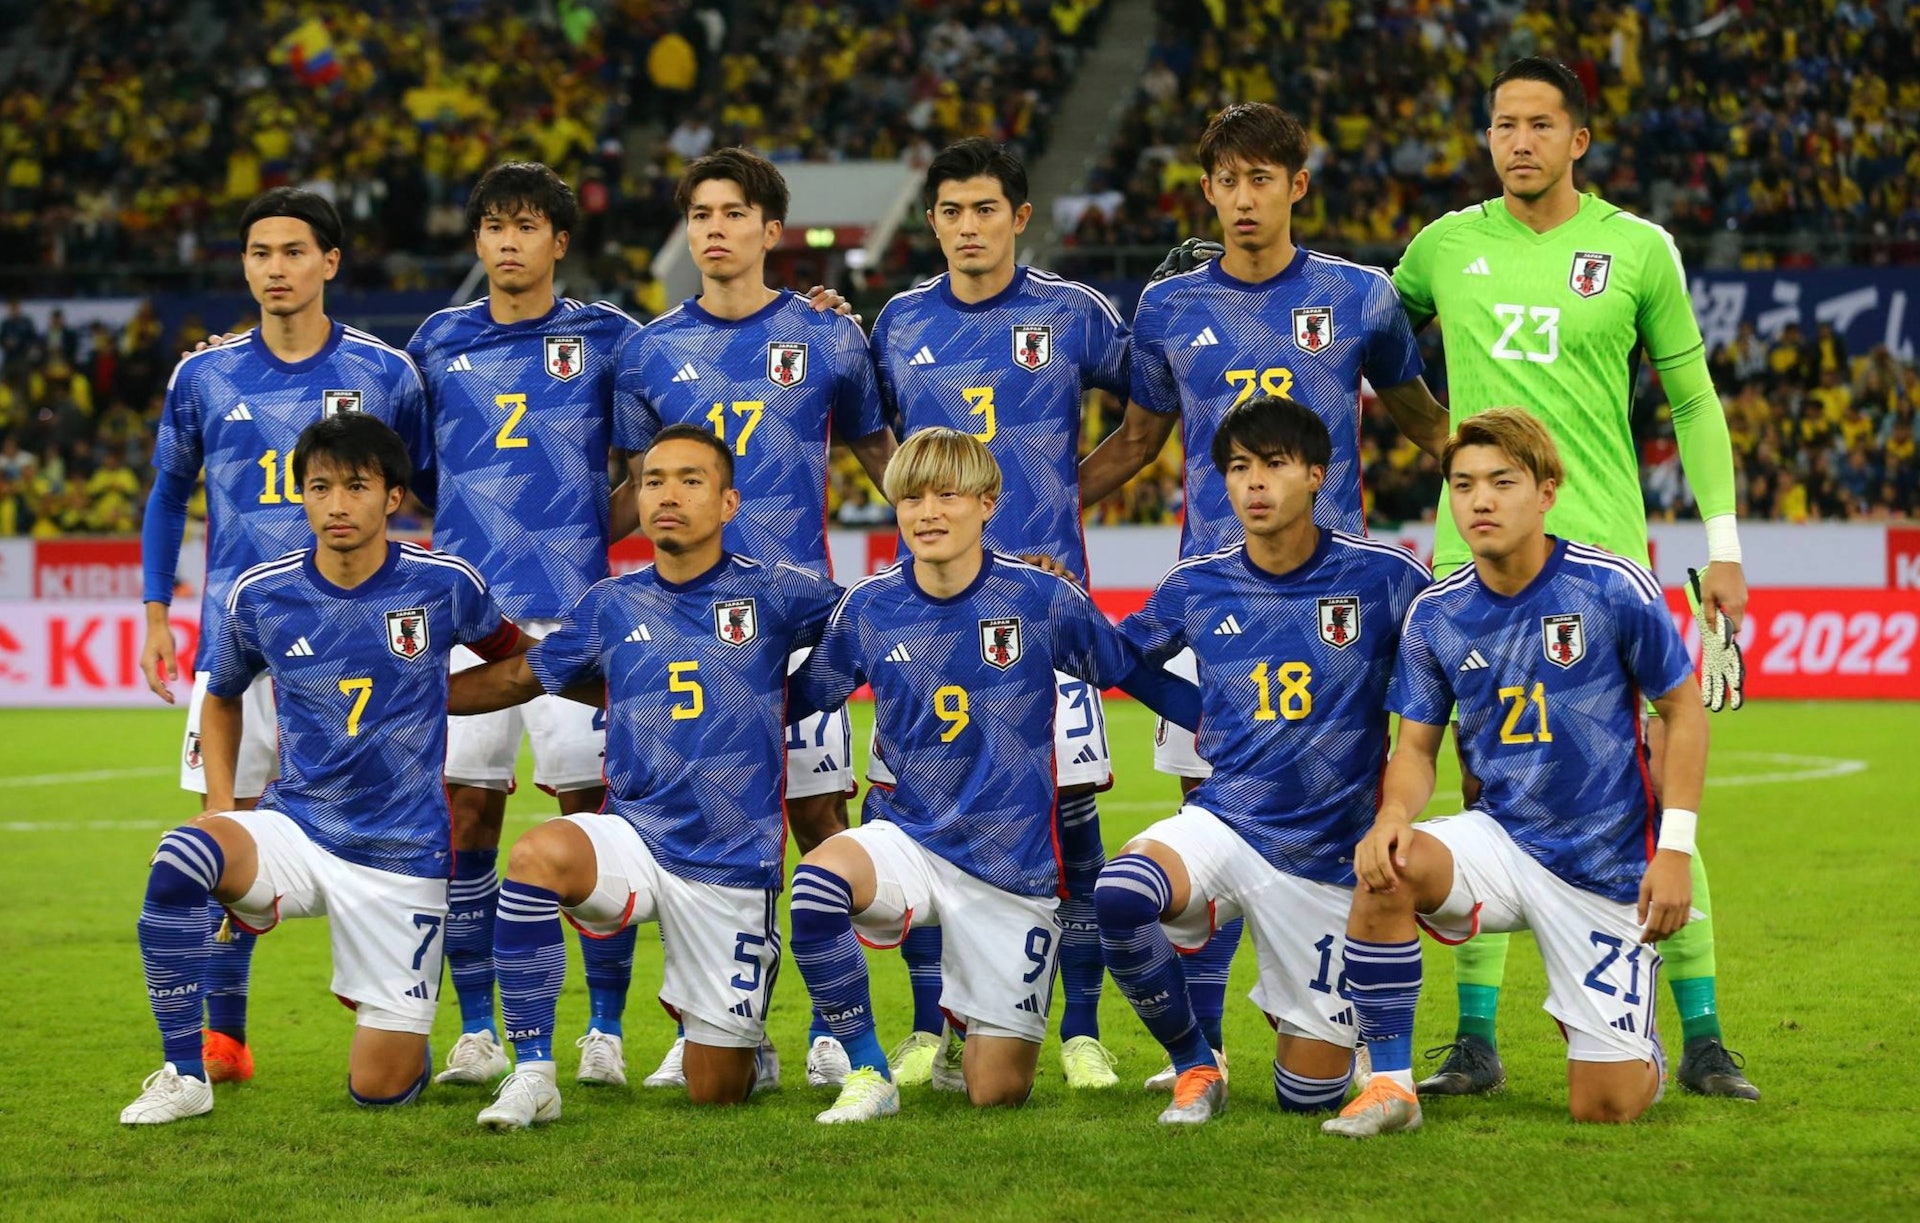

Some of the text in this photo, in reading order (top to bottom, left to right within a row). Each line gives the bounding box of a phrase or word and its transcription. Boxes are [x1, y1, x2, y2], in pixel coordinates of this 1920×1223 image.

[1491, 303, 1560, 364] 23
[495, 393, 528, 449] 2
[706, 401, 765, 455] 17
[962, 386, 996, 443] 3
[1760, 610, 1919, 675] 2022
[338, 677, 373, 736] 7
[669, 660, 704, 720] 5
[934, 685, 969, 743] 9
[1059, 680, 1094, 739] 3
[1251, 661, 1312, 721] 18
[1498, 683, 1554, 744] 21
[412, 913, 441, 970] 7
[731, 932, 765, 992] 5
[1023, 926, 1052, 984] 9
[1583, 930, 1642, 1006] 21
